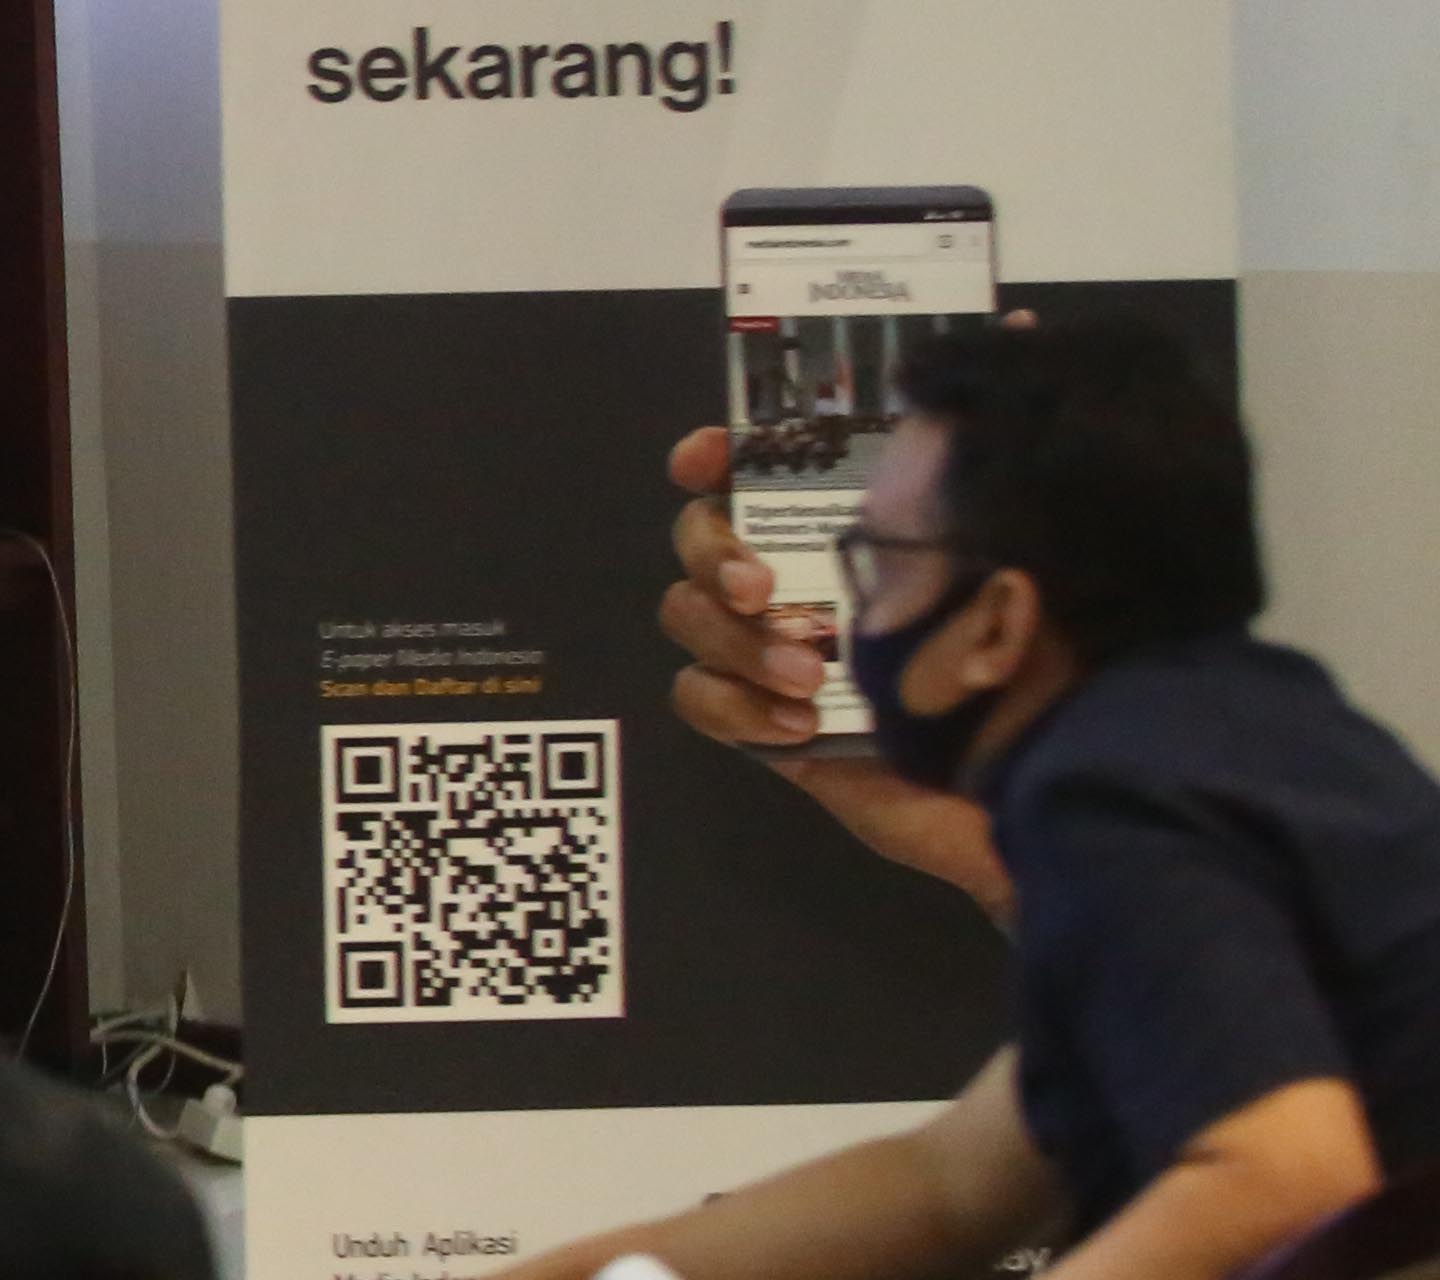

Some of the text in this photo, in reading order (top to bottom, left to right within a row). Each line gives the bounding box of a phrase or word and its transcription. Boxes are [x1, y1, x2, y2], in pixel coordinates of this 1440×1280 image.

[306, 19, 737, 114] sekarang!
[333, 1229, 519, 1263] Unduh Aplikasi
